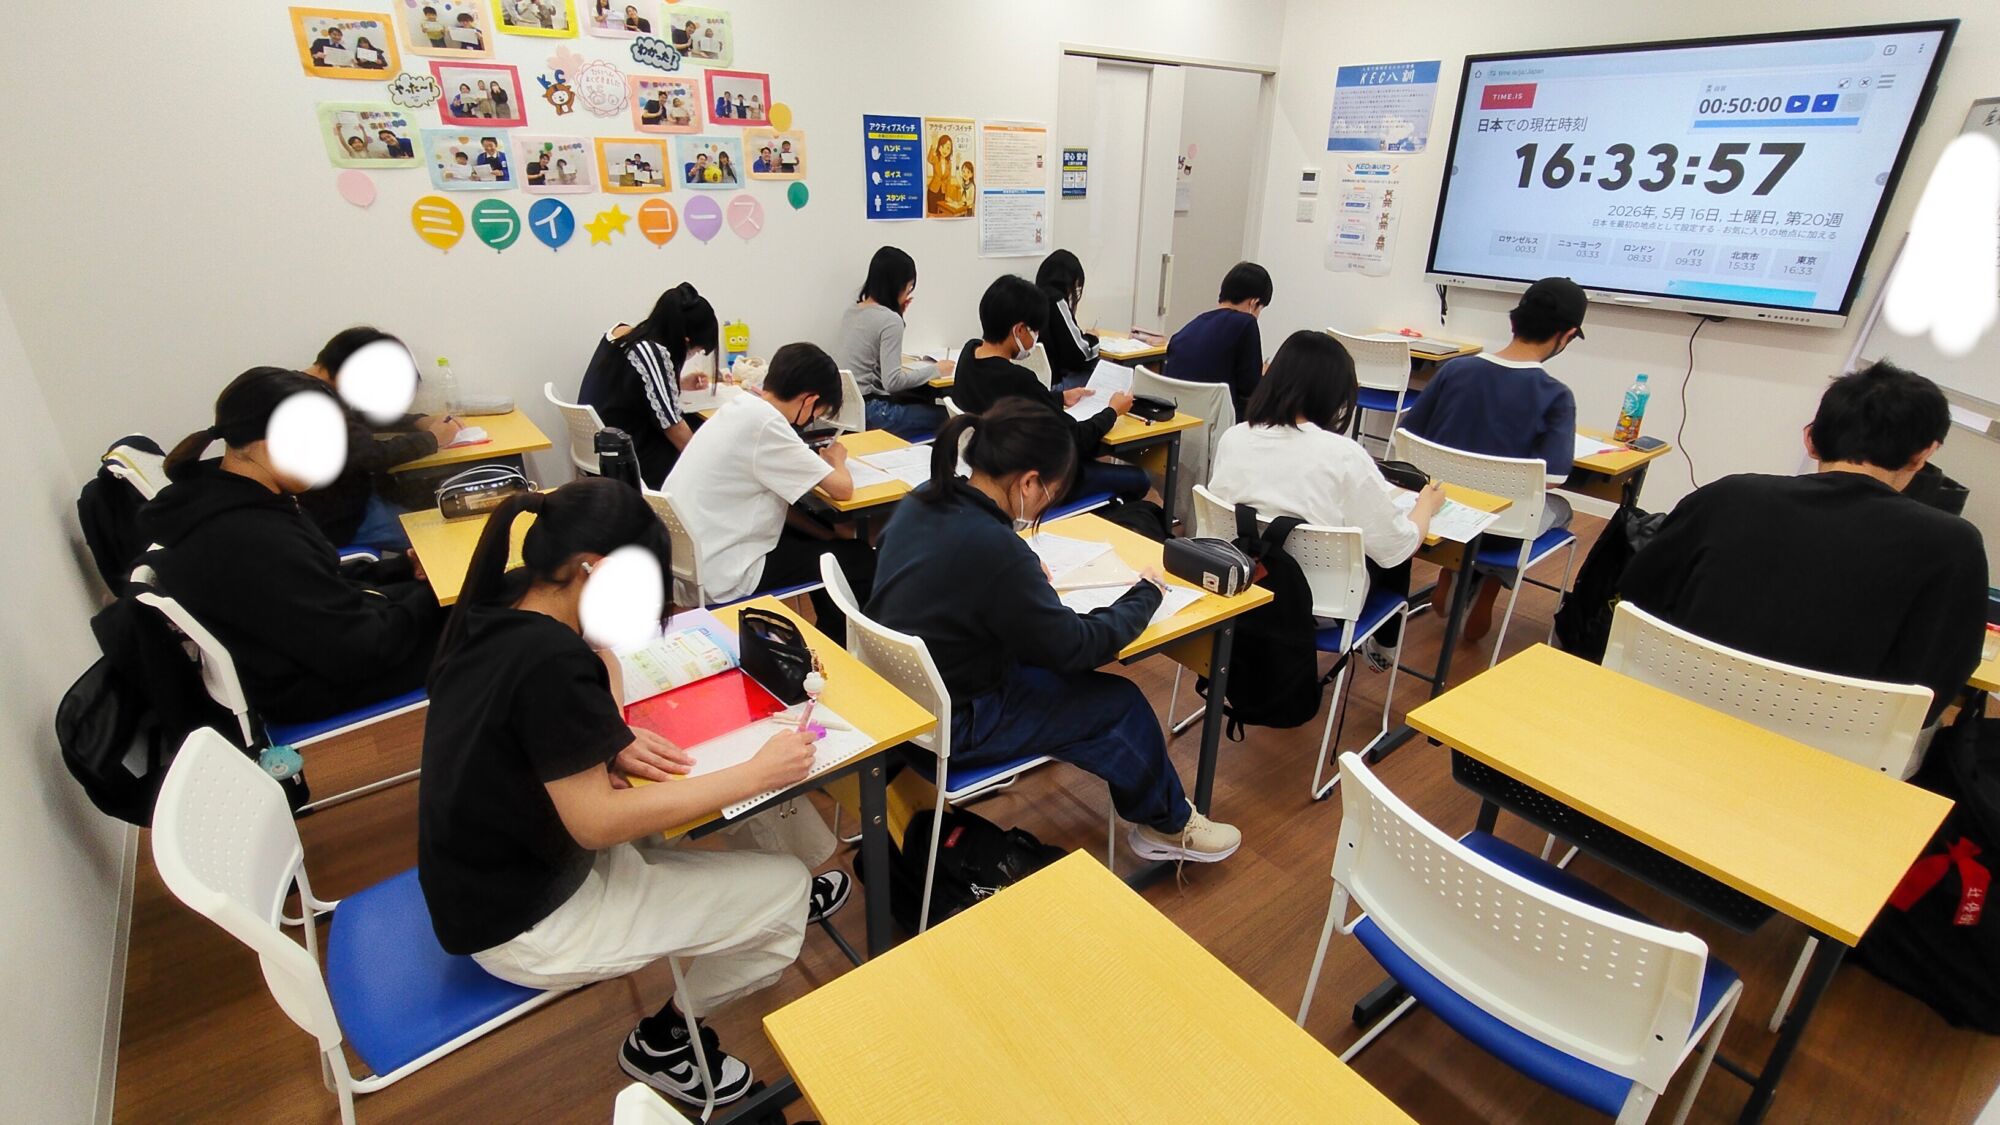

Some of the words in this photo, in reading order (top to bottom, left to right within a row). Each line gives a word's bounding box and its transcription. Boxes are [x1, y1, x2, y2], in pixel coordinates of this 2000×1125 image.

[1492, 92, 1524, 101] TIME.IS
[1699, 96, 1783, 114] 00:50:00
[1477, 116, 1588, 133] 日本での現在時刻
[883, 144, 901, 152] ハンド
[1516, 142, 1806, 195] 16:33:57
[886, 193, 907, 202] スタンド
[1607, 205, 1658, 220] 2026年,
[1661, 207, 1685, 220] 5月
[1690, 208, 1722, 222] 16日,
[1727, 209, 1779, 226] 土曜日,
[1784, 211, 1844, 228] 第20週
[1498, 235, 1539, 245] ロサンゼルス
[1558, 239, 1602, 249] ニューヨーク
[1623, 244, 1656, 253] ロンドン
[1687, 248, 1705, 257] パリ
[1730, 251, 1760, 261] 北京市
[1796, 255, 1818, 266] 東京
[1675, 257, 1703, 267] 09:33
[1728, 261, 1757, 272] 15:33
[1783, 265, 1814, 276] 16:33
